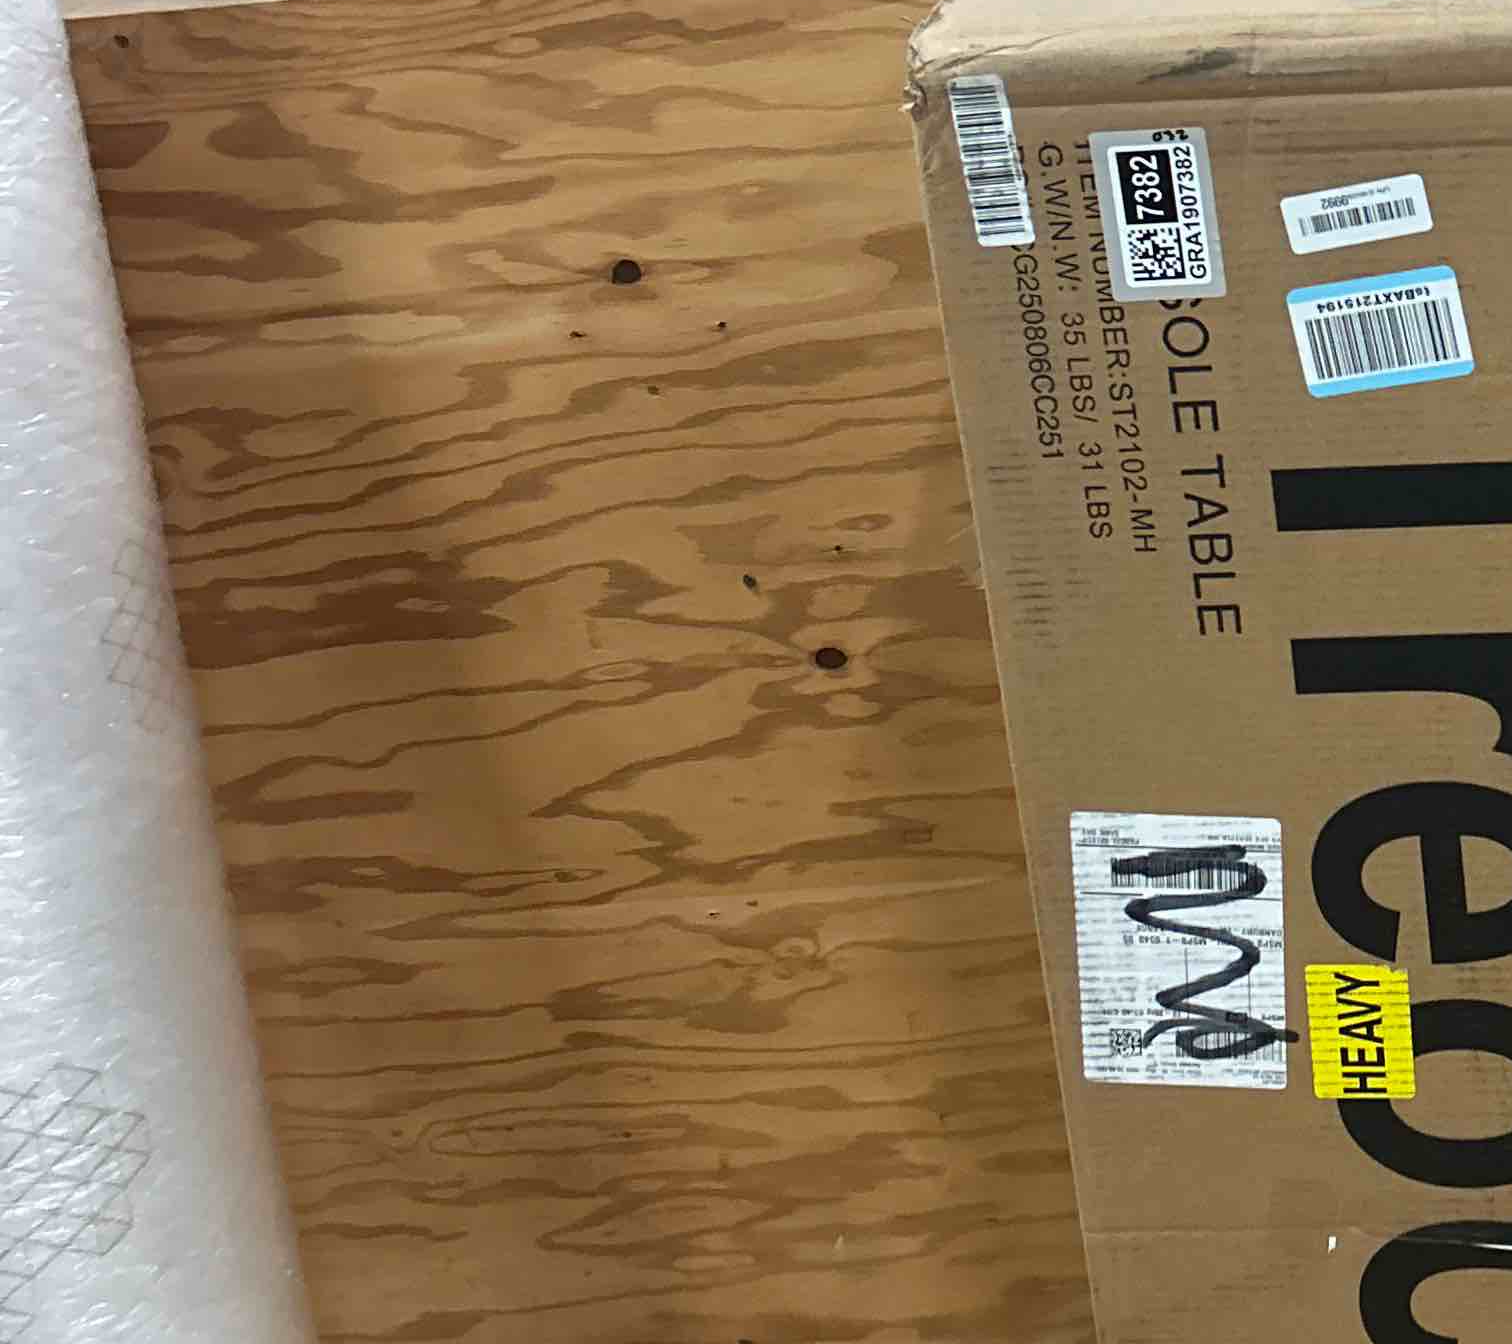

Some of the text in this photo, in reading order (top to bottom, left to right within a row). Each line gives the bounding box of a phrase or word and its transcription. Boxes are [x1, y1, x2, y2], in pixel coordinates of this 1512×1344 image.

[1129, 154, 1166, 220] 7382
[1173, 145, 1207, 279] GRA1907382
[1036, 143, 1113, 540] G.W/N.W: 35 LBS/ 31 LBS
[1184, 453, 1242, 637] TABLE
[1334, 971, 1389, 1097] HEAVY
